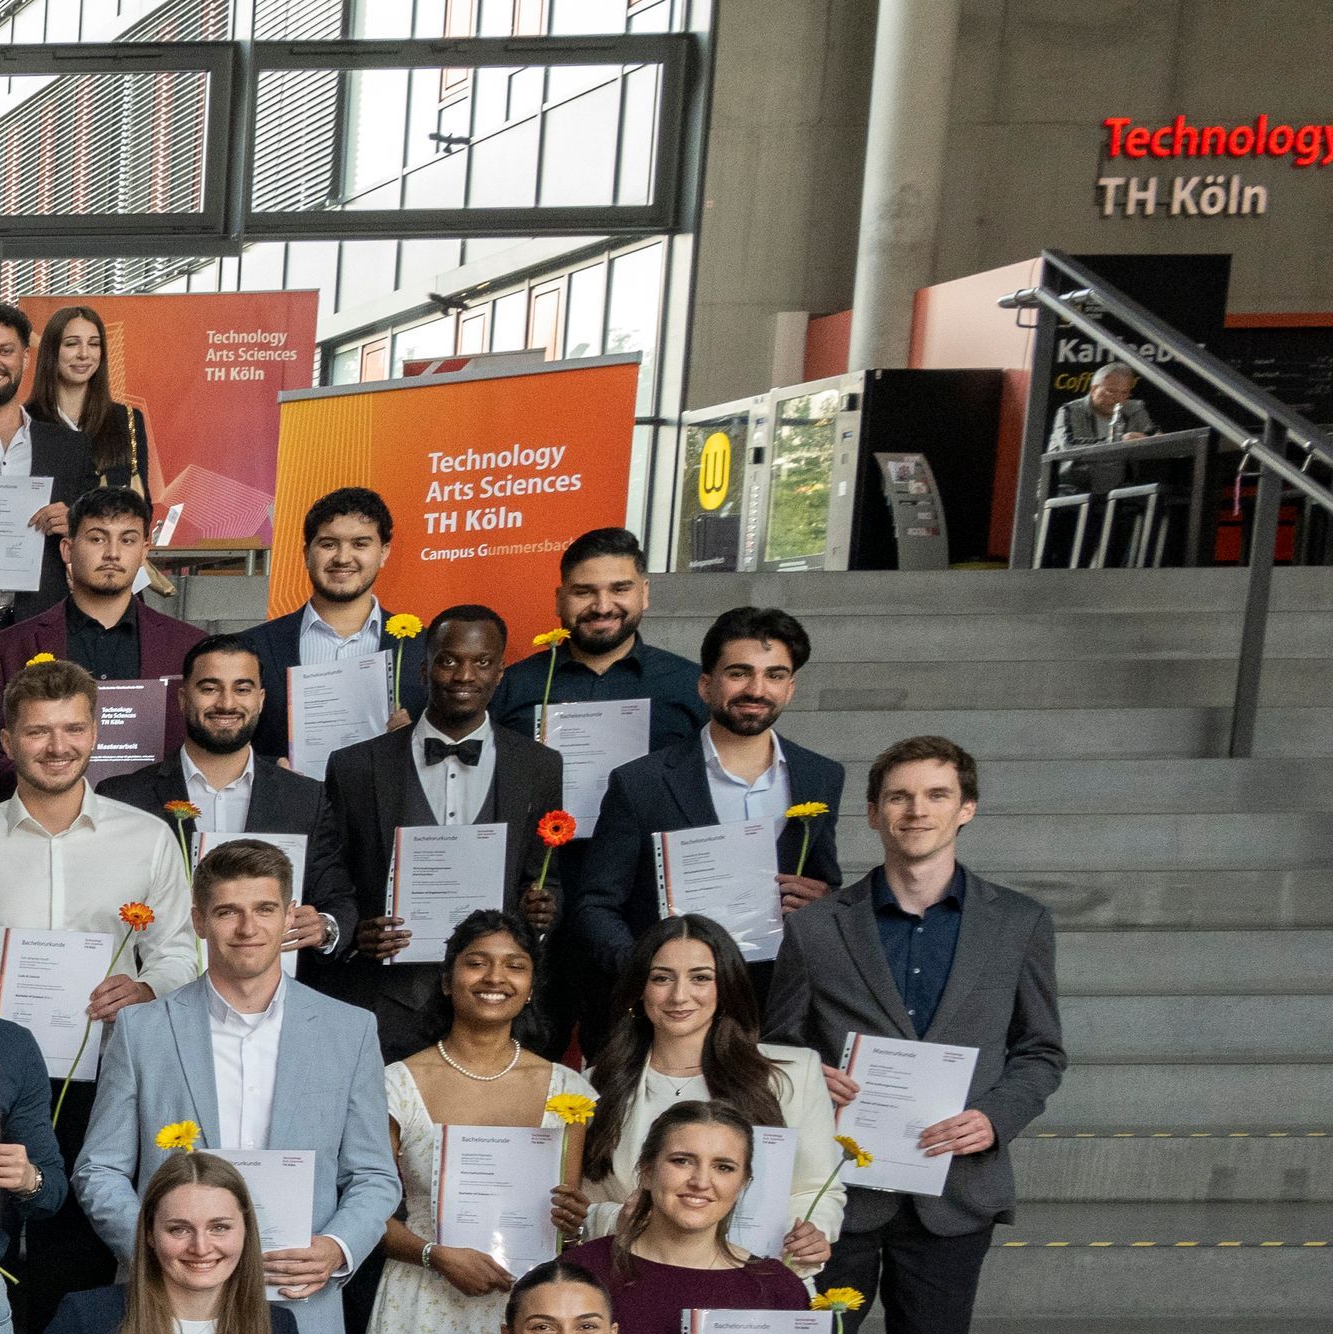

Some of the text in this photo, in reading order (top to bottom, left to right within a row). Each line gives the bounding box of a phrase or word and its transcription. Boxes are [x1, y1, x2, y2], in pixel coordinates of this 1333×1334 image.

[1097, 173, 1268, 217] TH Köln
[206, 330, 287, 346] Technology
[206, 348, 297, 362] Arts Sciences
[205, 366, 264, 381] TH Köln
[428, 443, 566, 474] Technology
[426, 472, 581, 502] Arts Sciences
[424, 506, 523, 535] TH Köln
[420, 545, 475, 563] Campus
[461, 1136, 510, 1144] Bachelorurkunde
[714, 1322, 771, 1331] Bachelorurkunde
